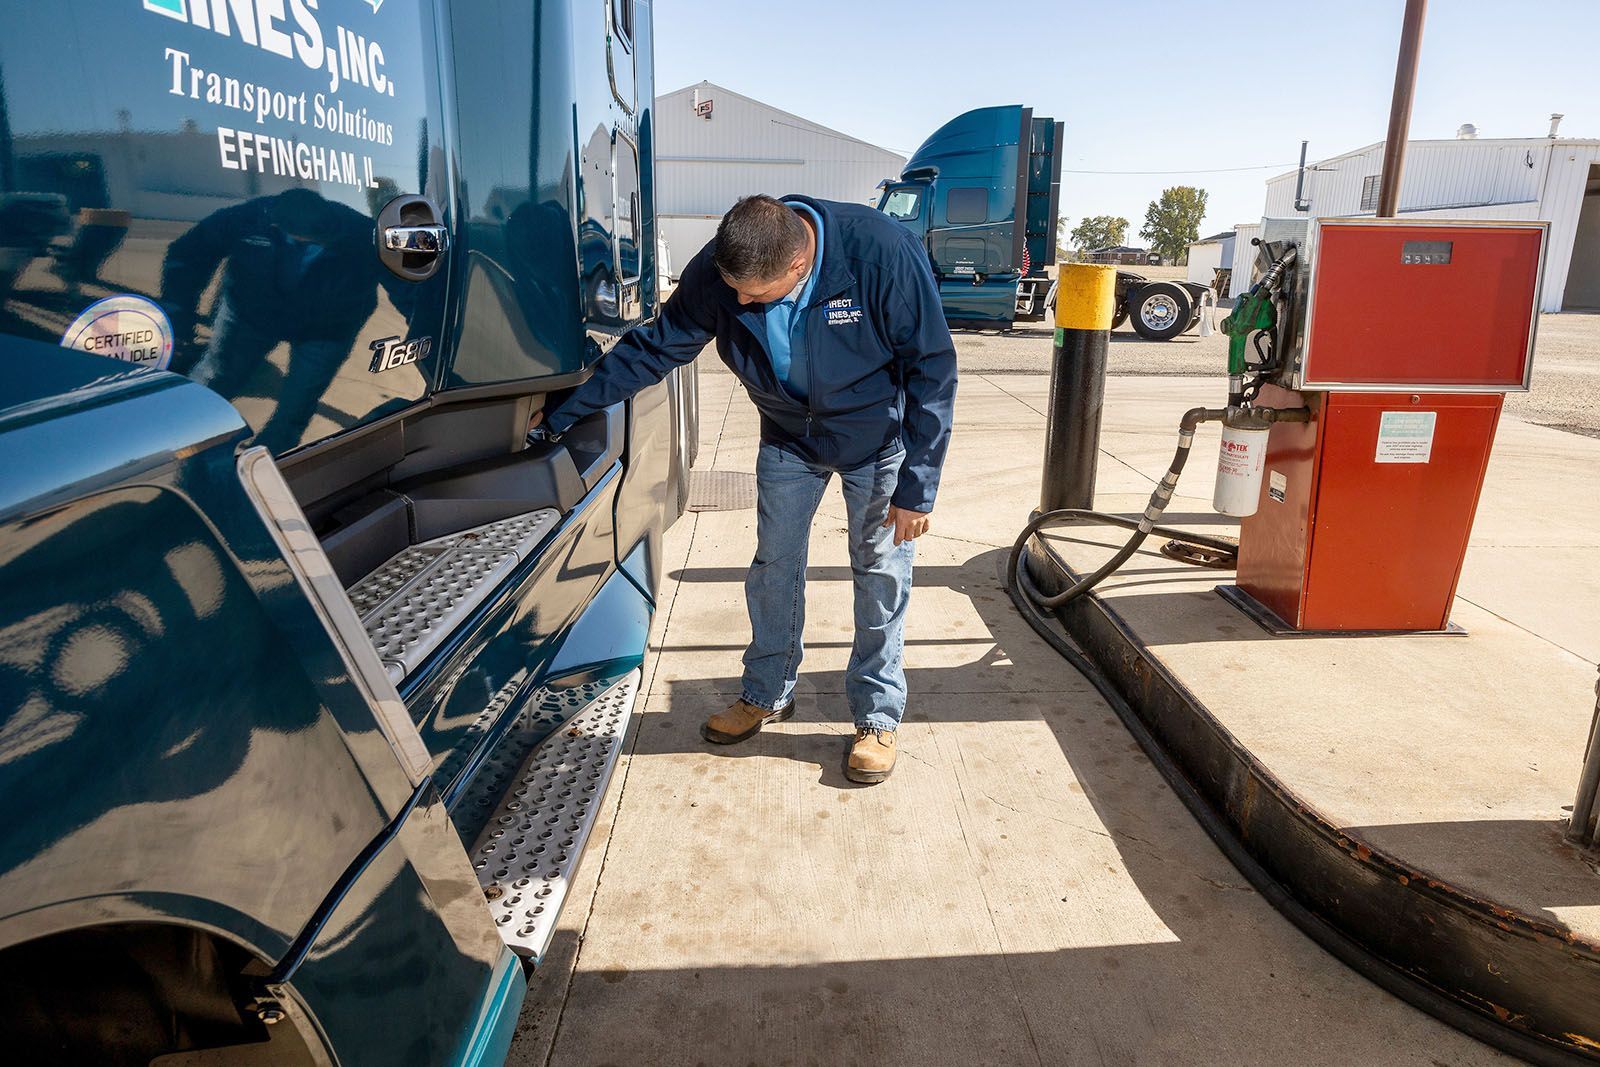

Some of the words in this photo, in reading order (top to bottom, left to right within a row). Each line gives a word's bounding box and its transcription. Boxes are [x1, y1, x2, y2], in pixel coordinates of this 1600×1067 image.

[165, 48, 306, 125] Transport
[313, 93, 393, 146] Solutions
[217, 127, 362, 192] EFFINGHAM,
[364, 156, 379, 189] IL
[83, 330, 153, 351] CERTIFIED
[130, 346, 158, 362] IDLE
[368, 335, 432, 374] T680
